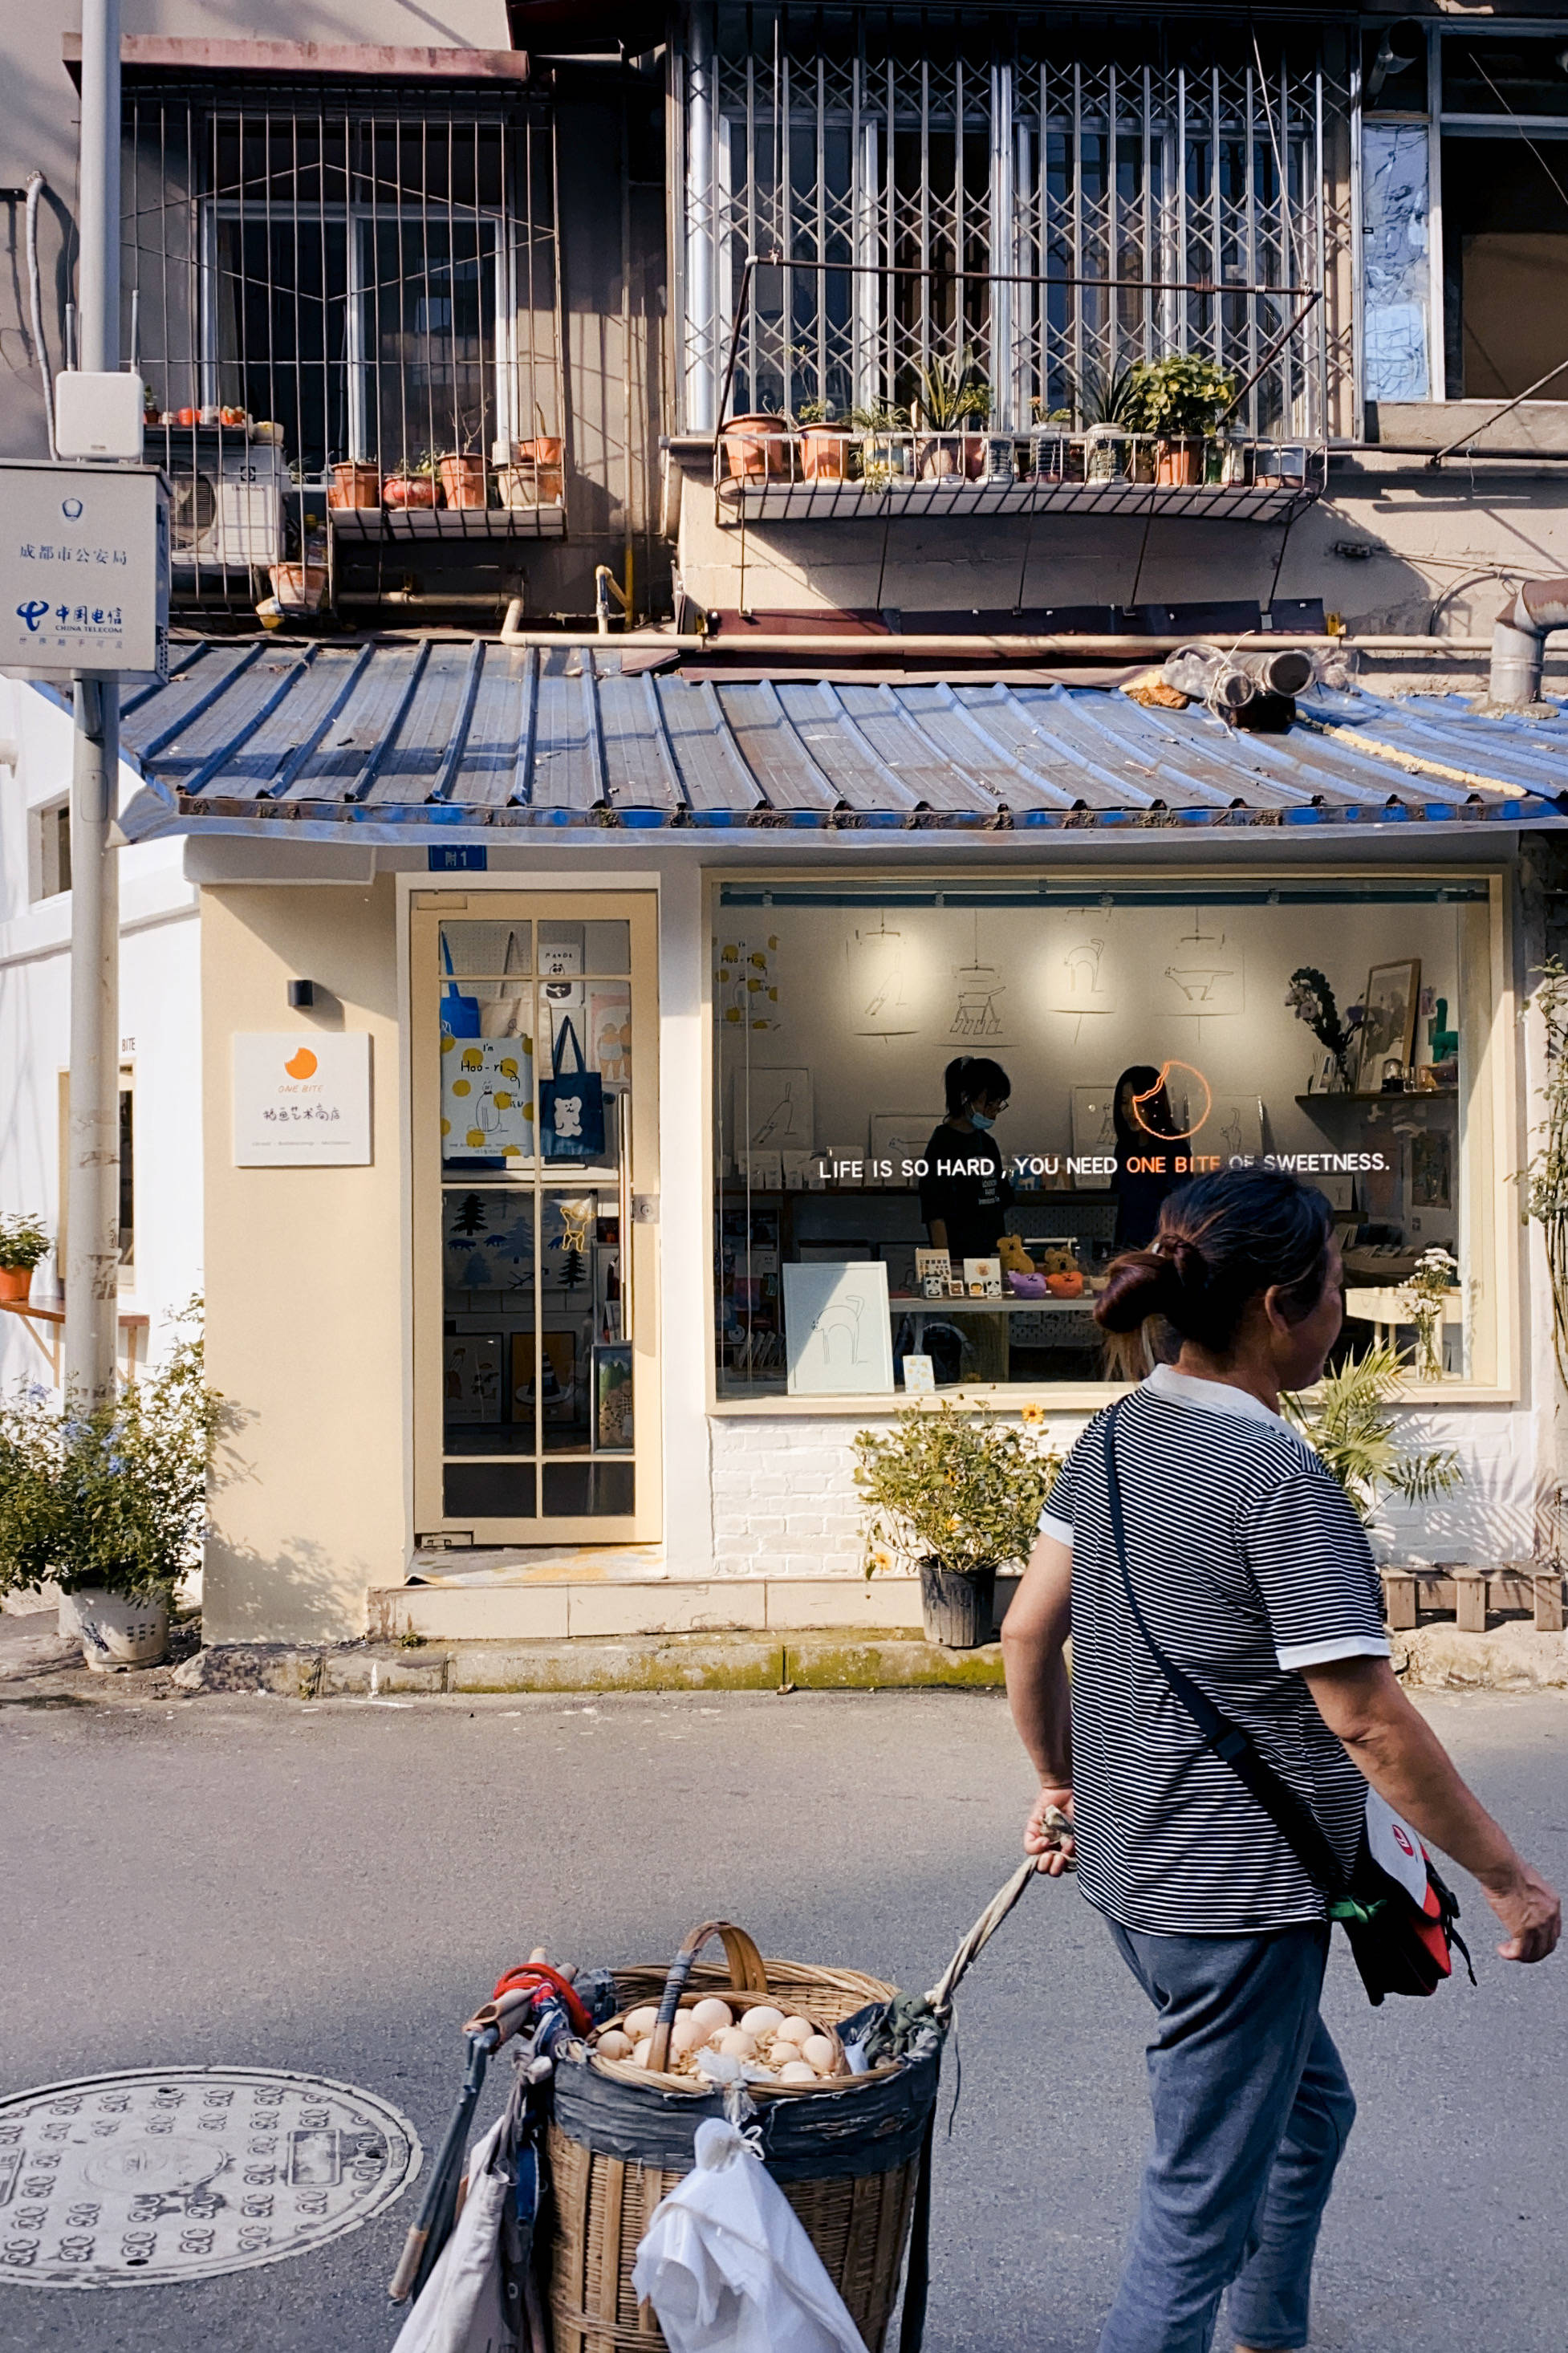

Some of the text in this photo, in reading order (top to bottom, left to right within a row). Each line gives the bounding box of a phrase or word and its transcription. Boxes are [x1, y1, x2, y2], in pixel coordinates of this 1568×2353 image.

[20, 544, 128, 566] 成都市公安局
[55, 603, 123, 624] 中国电信
[122, 1038, 136, 1051] BITE
[483, 1043, 494, 1051] I'm
[278, 1085, 323, 1093] ONE BITE
[819, 1160, 863, 1179] LIFE
[873, 1160, 892, 1178] IS
[901, 1160, 929, 1177] SO
[1014, 1158, 1059, 1176] YOU
[1066, 1156, 1118, 1175] NEED
[1127, 1156, 1166, 1173] ONE
[1175, 1156, 1221, 1173] BITE
[1229, 1155, 1255, 1169] OF
[1264, 1153, 1390, 1172] SWEETNESS.
